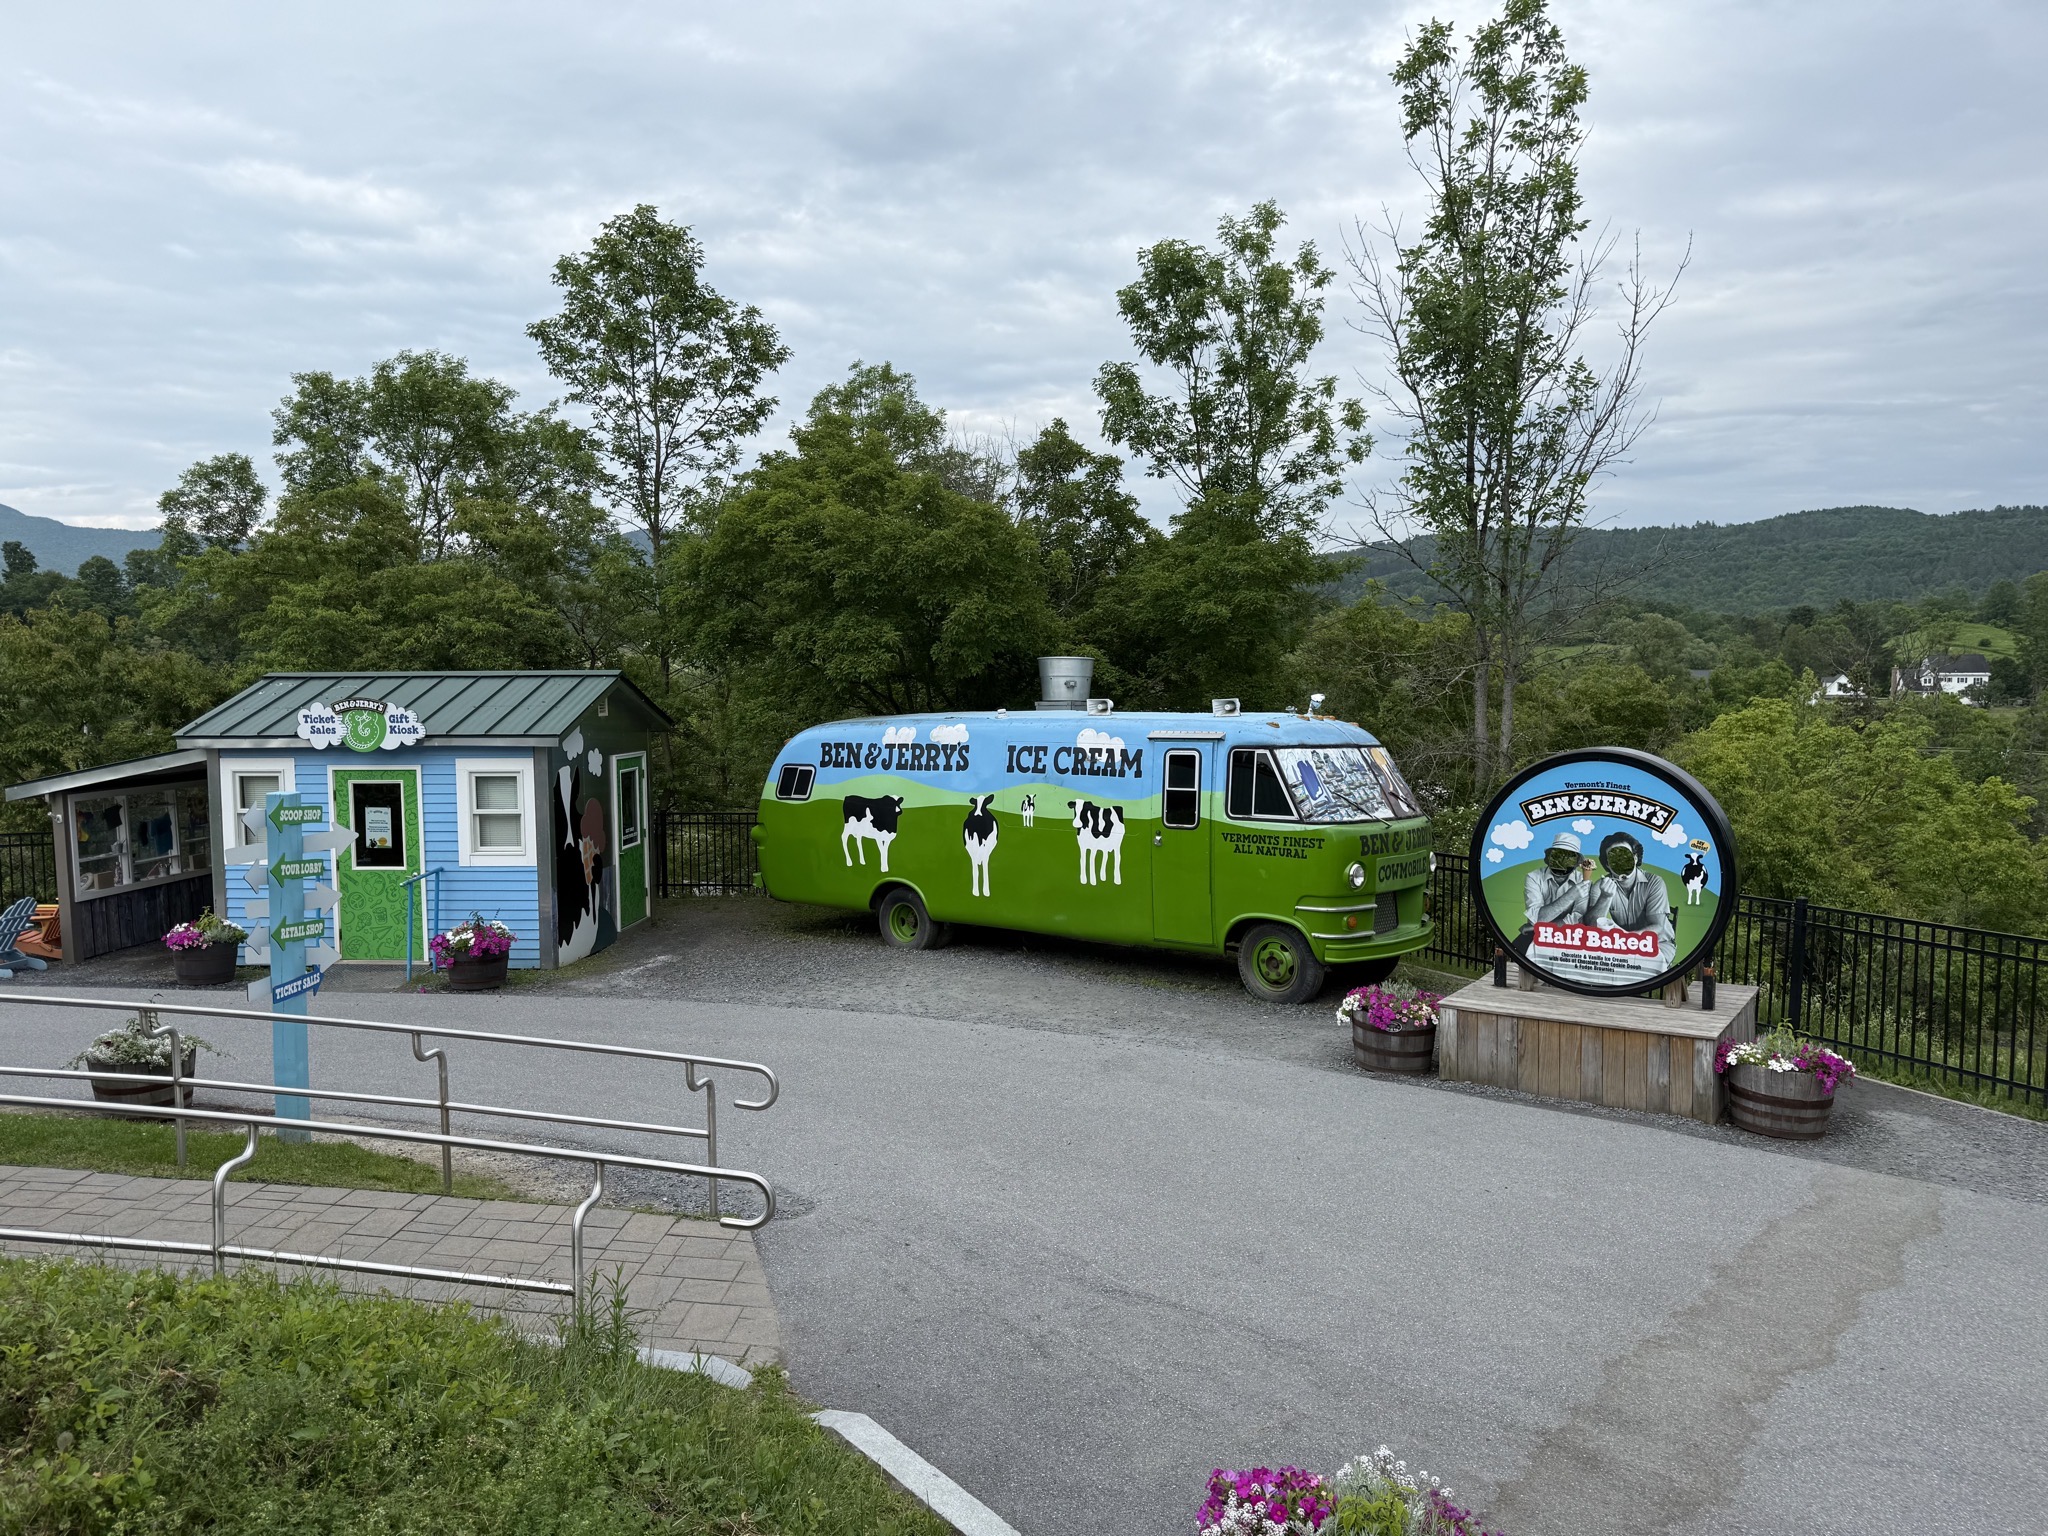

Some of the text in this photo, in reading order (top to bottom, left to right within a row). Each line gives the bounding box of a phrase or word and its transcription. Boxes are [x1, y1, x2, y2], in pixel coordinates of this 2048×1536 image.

[302, 714, 336, 724] Ticket
[388, 713, 410, 724] Gift
[310, 725, 337, 735] Sales
[389, 725, 420, 735] Kiosk
[1006, 745, 1049, 774] ICE
[1053, 746, 1143, 778] CREAM
[1564, 781, 1631, 791] Vermont's Finest
[280, 809, 322, 822] SCOOP SHOP
[1221, 832, 1326, 850] VERMONT'S FINEST
[1359, 833, 1391, 857] BEN
[1392, 831, 1404, 853] &
[1233, 843, 1308, 860] ALL NATURAL
[281, 862, 323, 876] TOUR LOBBY
[1378, 856, 1427, 883] COWMOBILE
[281, 922, 324, 940] RETAIL SHOP
[1538, 926, 1654, 953] Half Baked
[275, 972, 321, 1000] TICKET SALES
